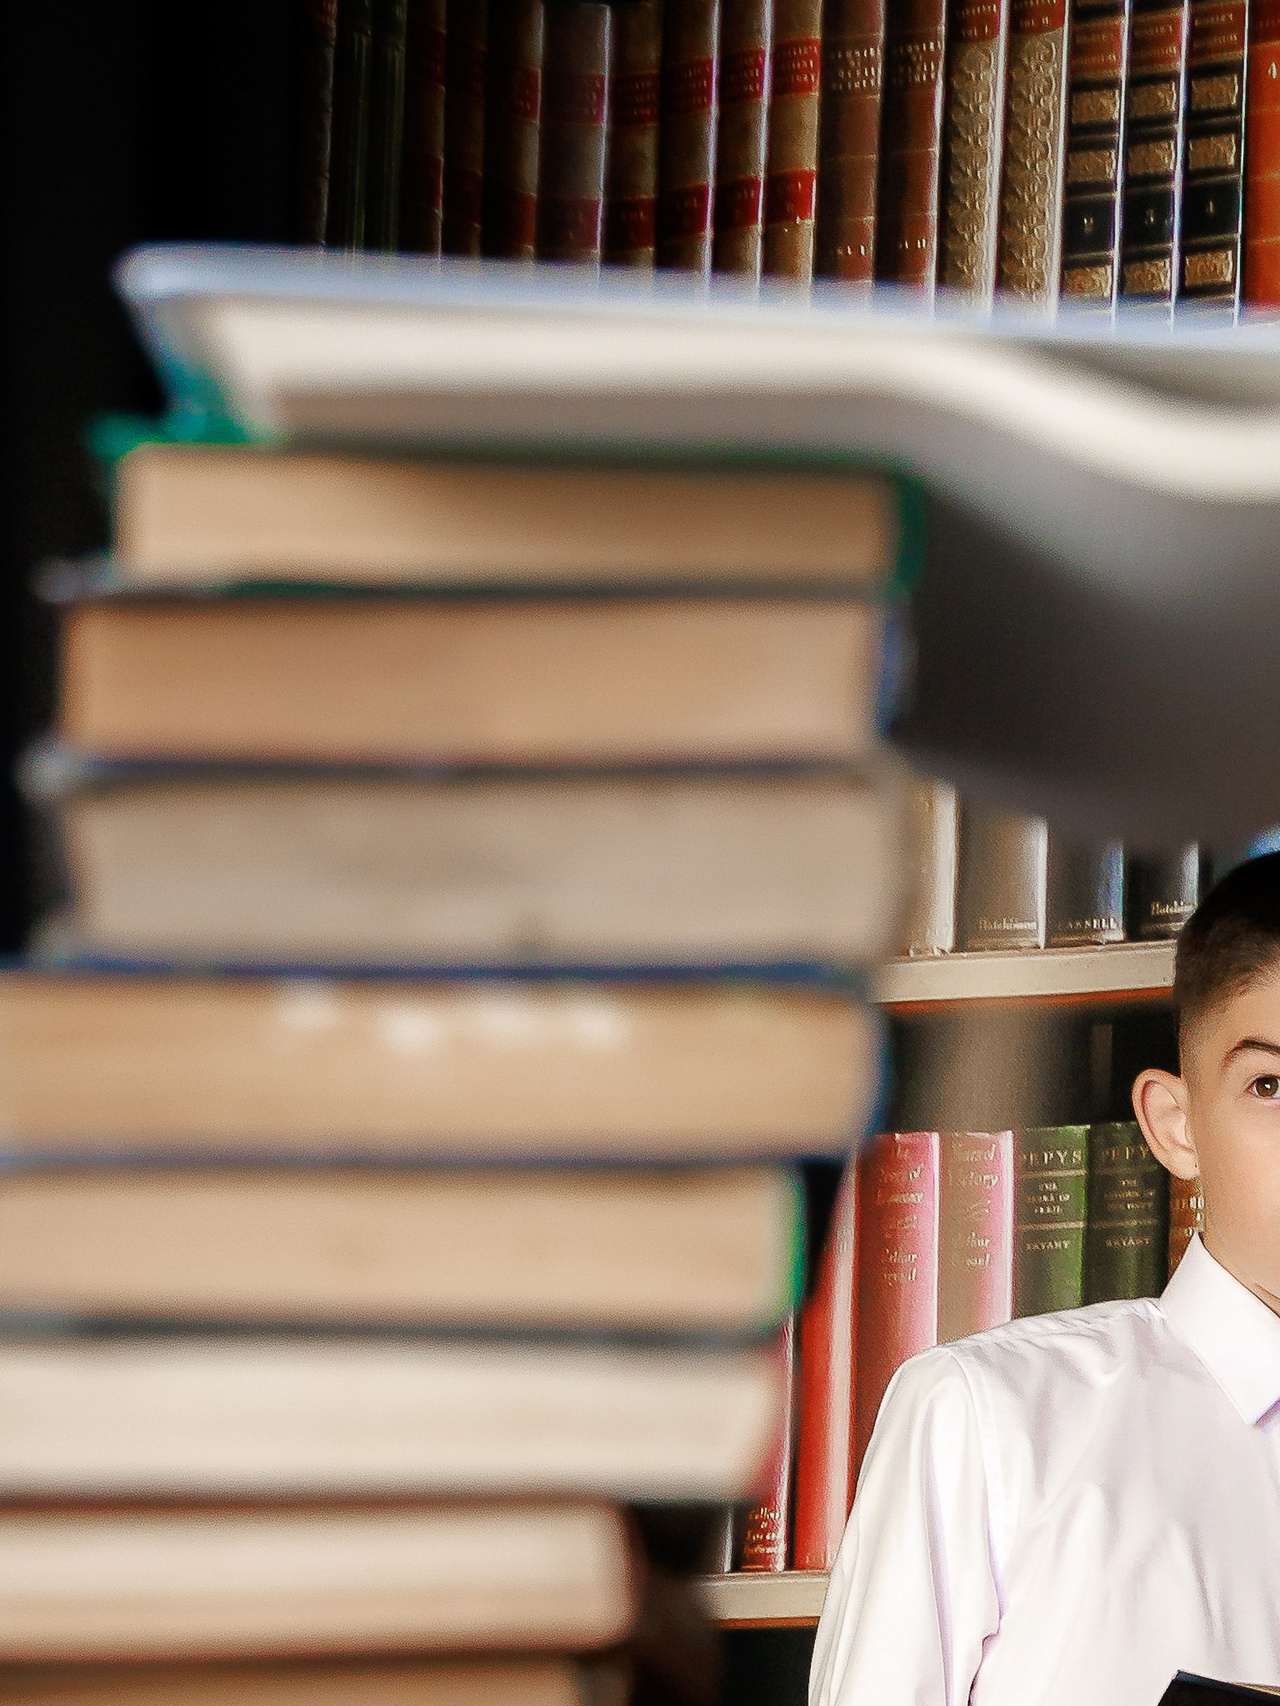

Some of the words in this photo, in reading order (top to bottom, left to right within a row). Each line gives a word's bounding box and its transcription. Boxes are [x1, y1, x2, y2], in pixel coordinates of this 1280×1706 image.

[1150, 900, 1197, 916] Hutchin
[1020, 1149, 1082, 1167] PEPYS
[1101, 1145, 1150, 1161] PEPY
